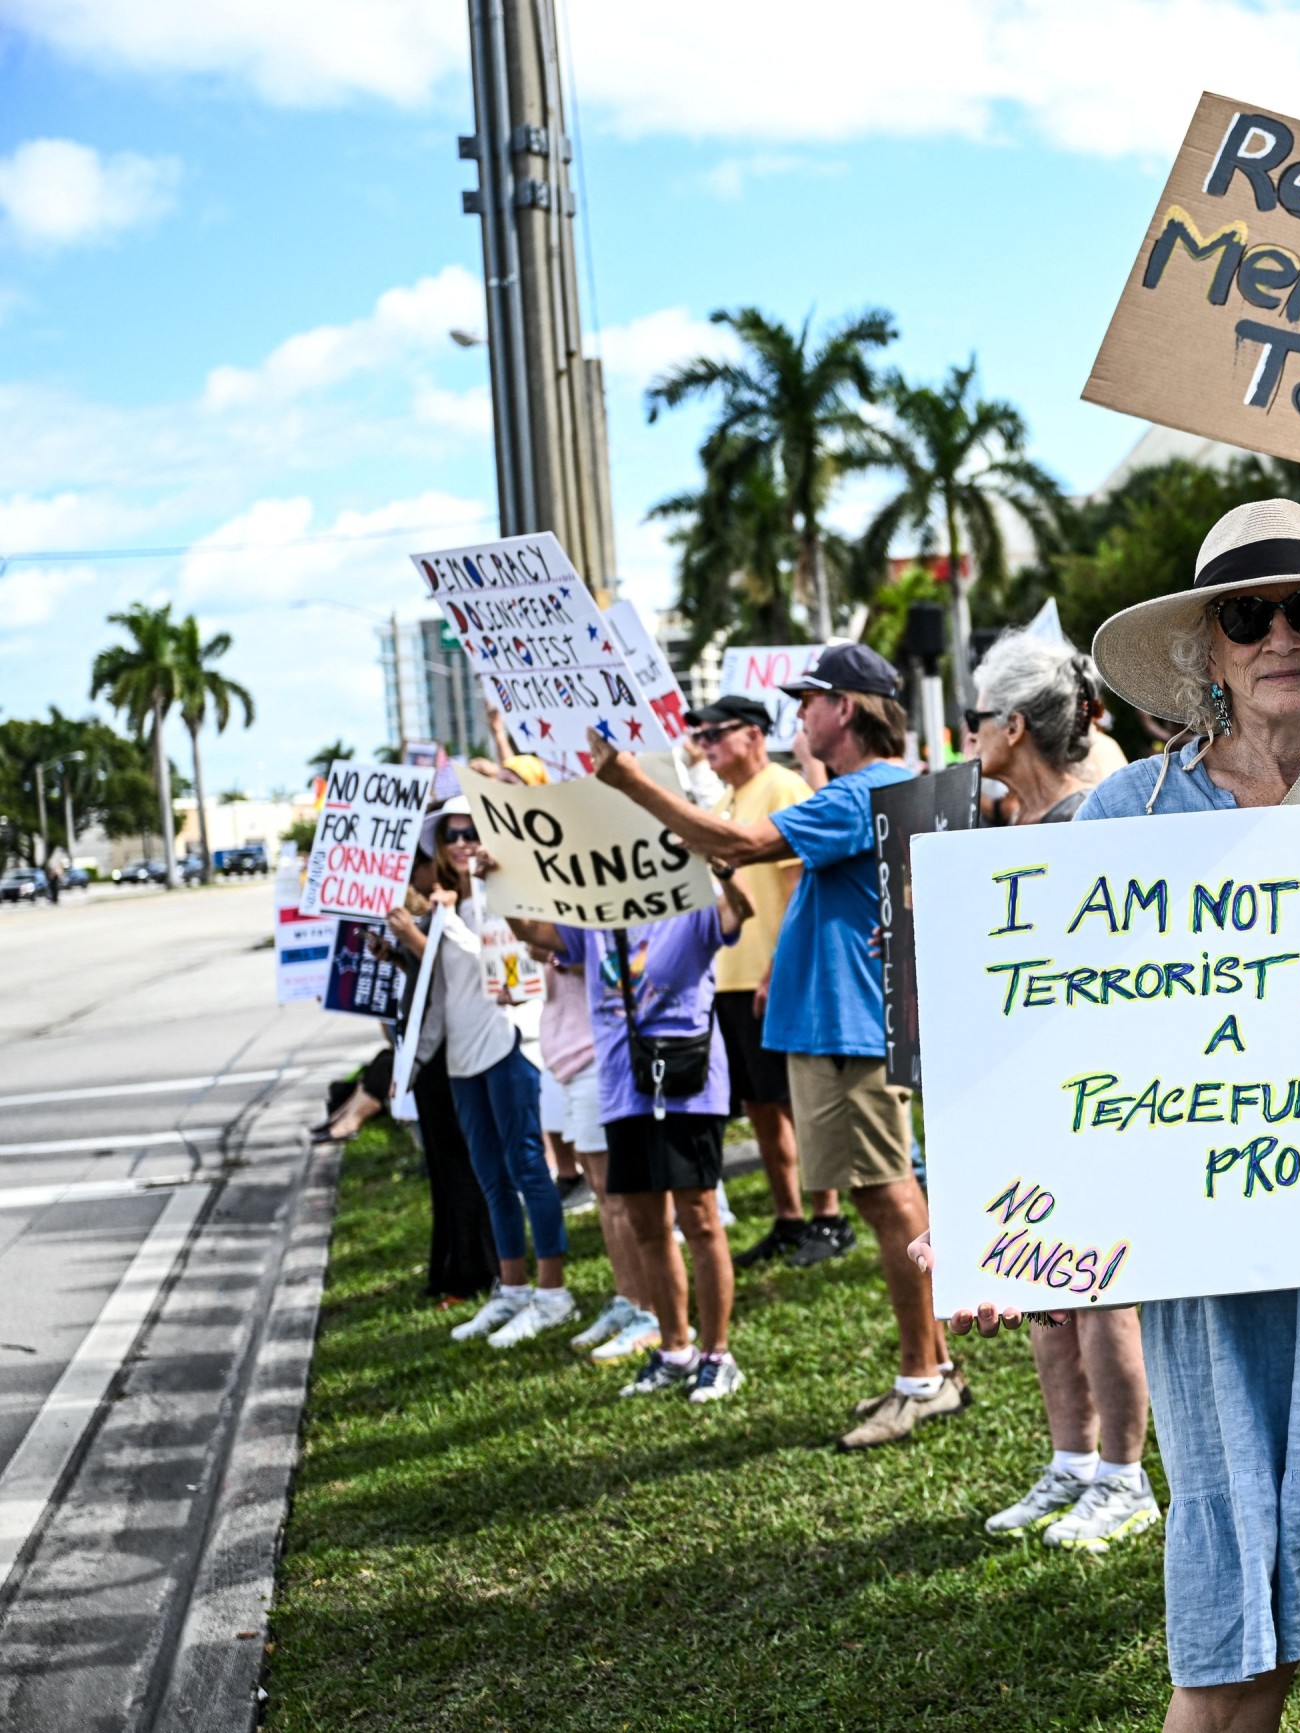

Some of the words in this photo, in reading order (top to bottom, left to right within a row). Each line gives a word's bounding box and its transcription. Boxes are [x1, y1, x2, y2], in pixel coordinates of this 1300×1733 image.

[421, 545, 550, 592] DEMOCRACY
[482, 634, 580, 670] PROTEST
[744, 652, 792, 692] NO
[490, 672, 599, 713] DICTATORS
[600, 669, 637, 708] DO
[327, 771, 359, 802] NO
[363, 773, 429, 811] CROWN
[321, 814, 360, 844] FOR
[371, 816, 412, 851] THE
[481, 793, 563, 848] NO
[328, 844, 410, 883] ORANGE
[533, 827, 690, 888] KINGS
[320, 875, 394, 913] CLOWN
[987, 866, 1047, 936] I
[1066, 875, 1169, 934] AM
[1192, 878, 1300, 935] NOT
[875, 812, 896, 1076] PROTECT
[1204, 1013, 1246, 1056] A
[985, 1180, 1056, 1224] NO
[981, 1228, 1128, 1303] KINGS!
